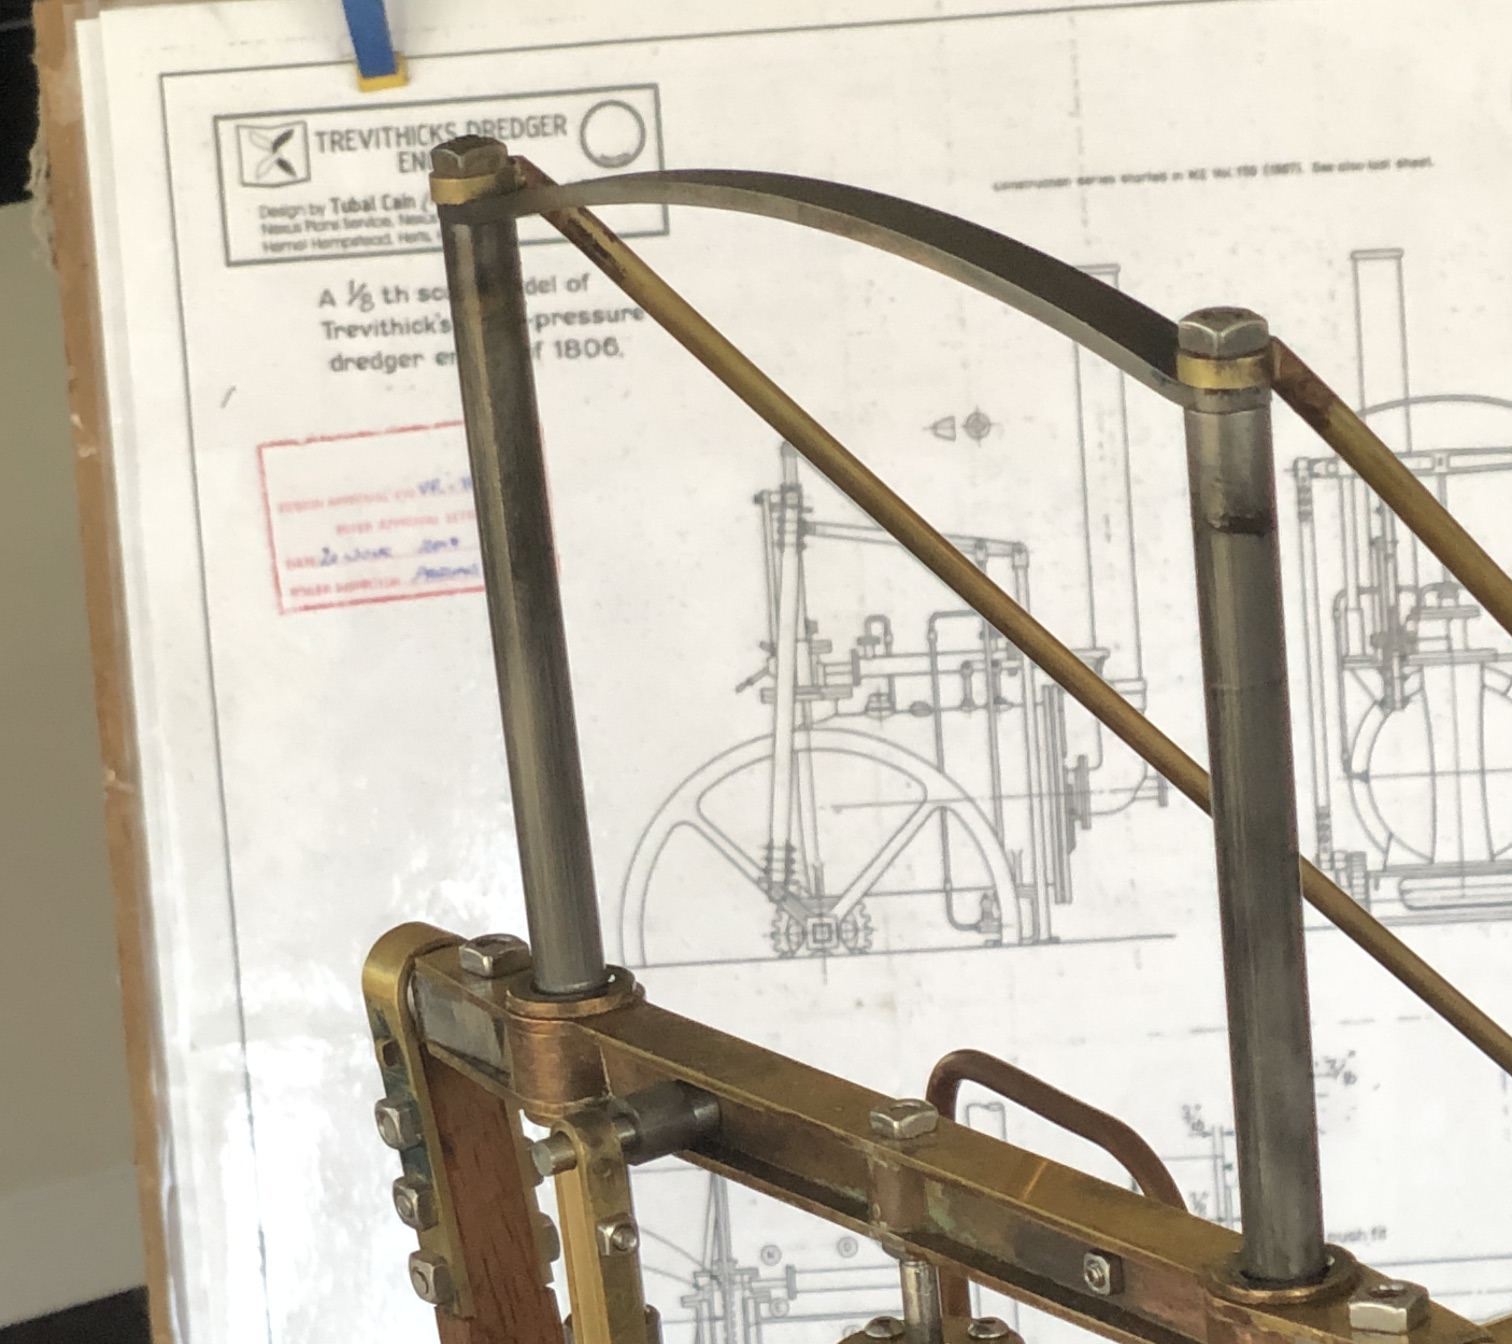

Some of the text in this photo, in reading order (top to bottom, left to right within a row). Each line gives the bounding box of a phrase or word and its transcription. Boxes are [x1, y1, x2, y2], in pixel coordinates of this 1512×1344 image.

[315, 113, 567, 154] TREVITHICKS DREDGER
[329, 195, 376, 214] Tubal
[381, 193, 416, 211] Cain
[318, 288, 337, 308] A
[381, 285, 410, 305] th
[525, 274, 557, 296] del
[566, 272, 590, 293] of
[321, 306, 646, 341] Trevithick's -pressure
[329, 350, 424, 375] dredger
[554, 335, 625, 361] 1806.
